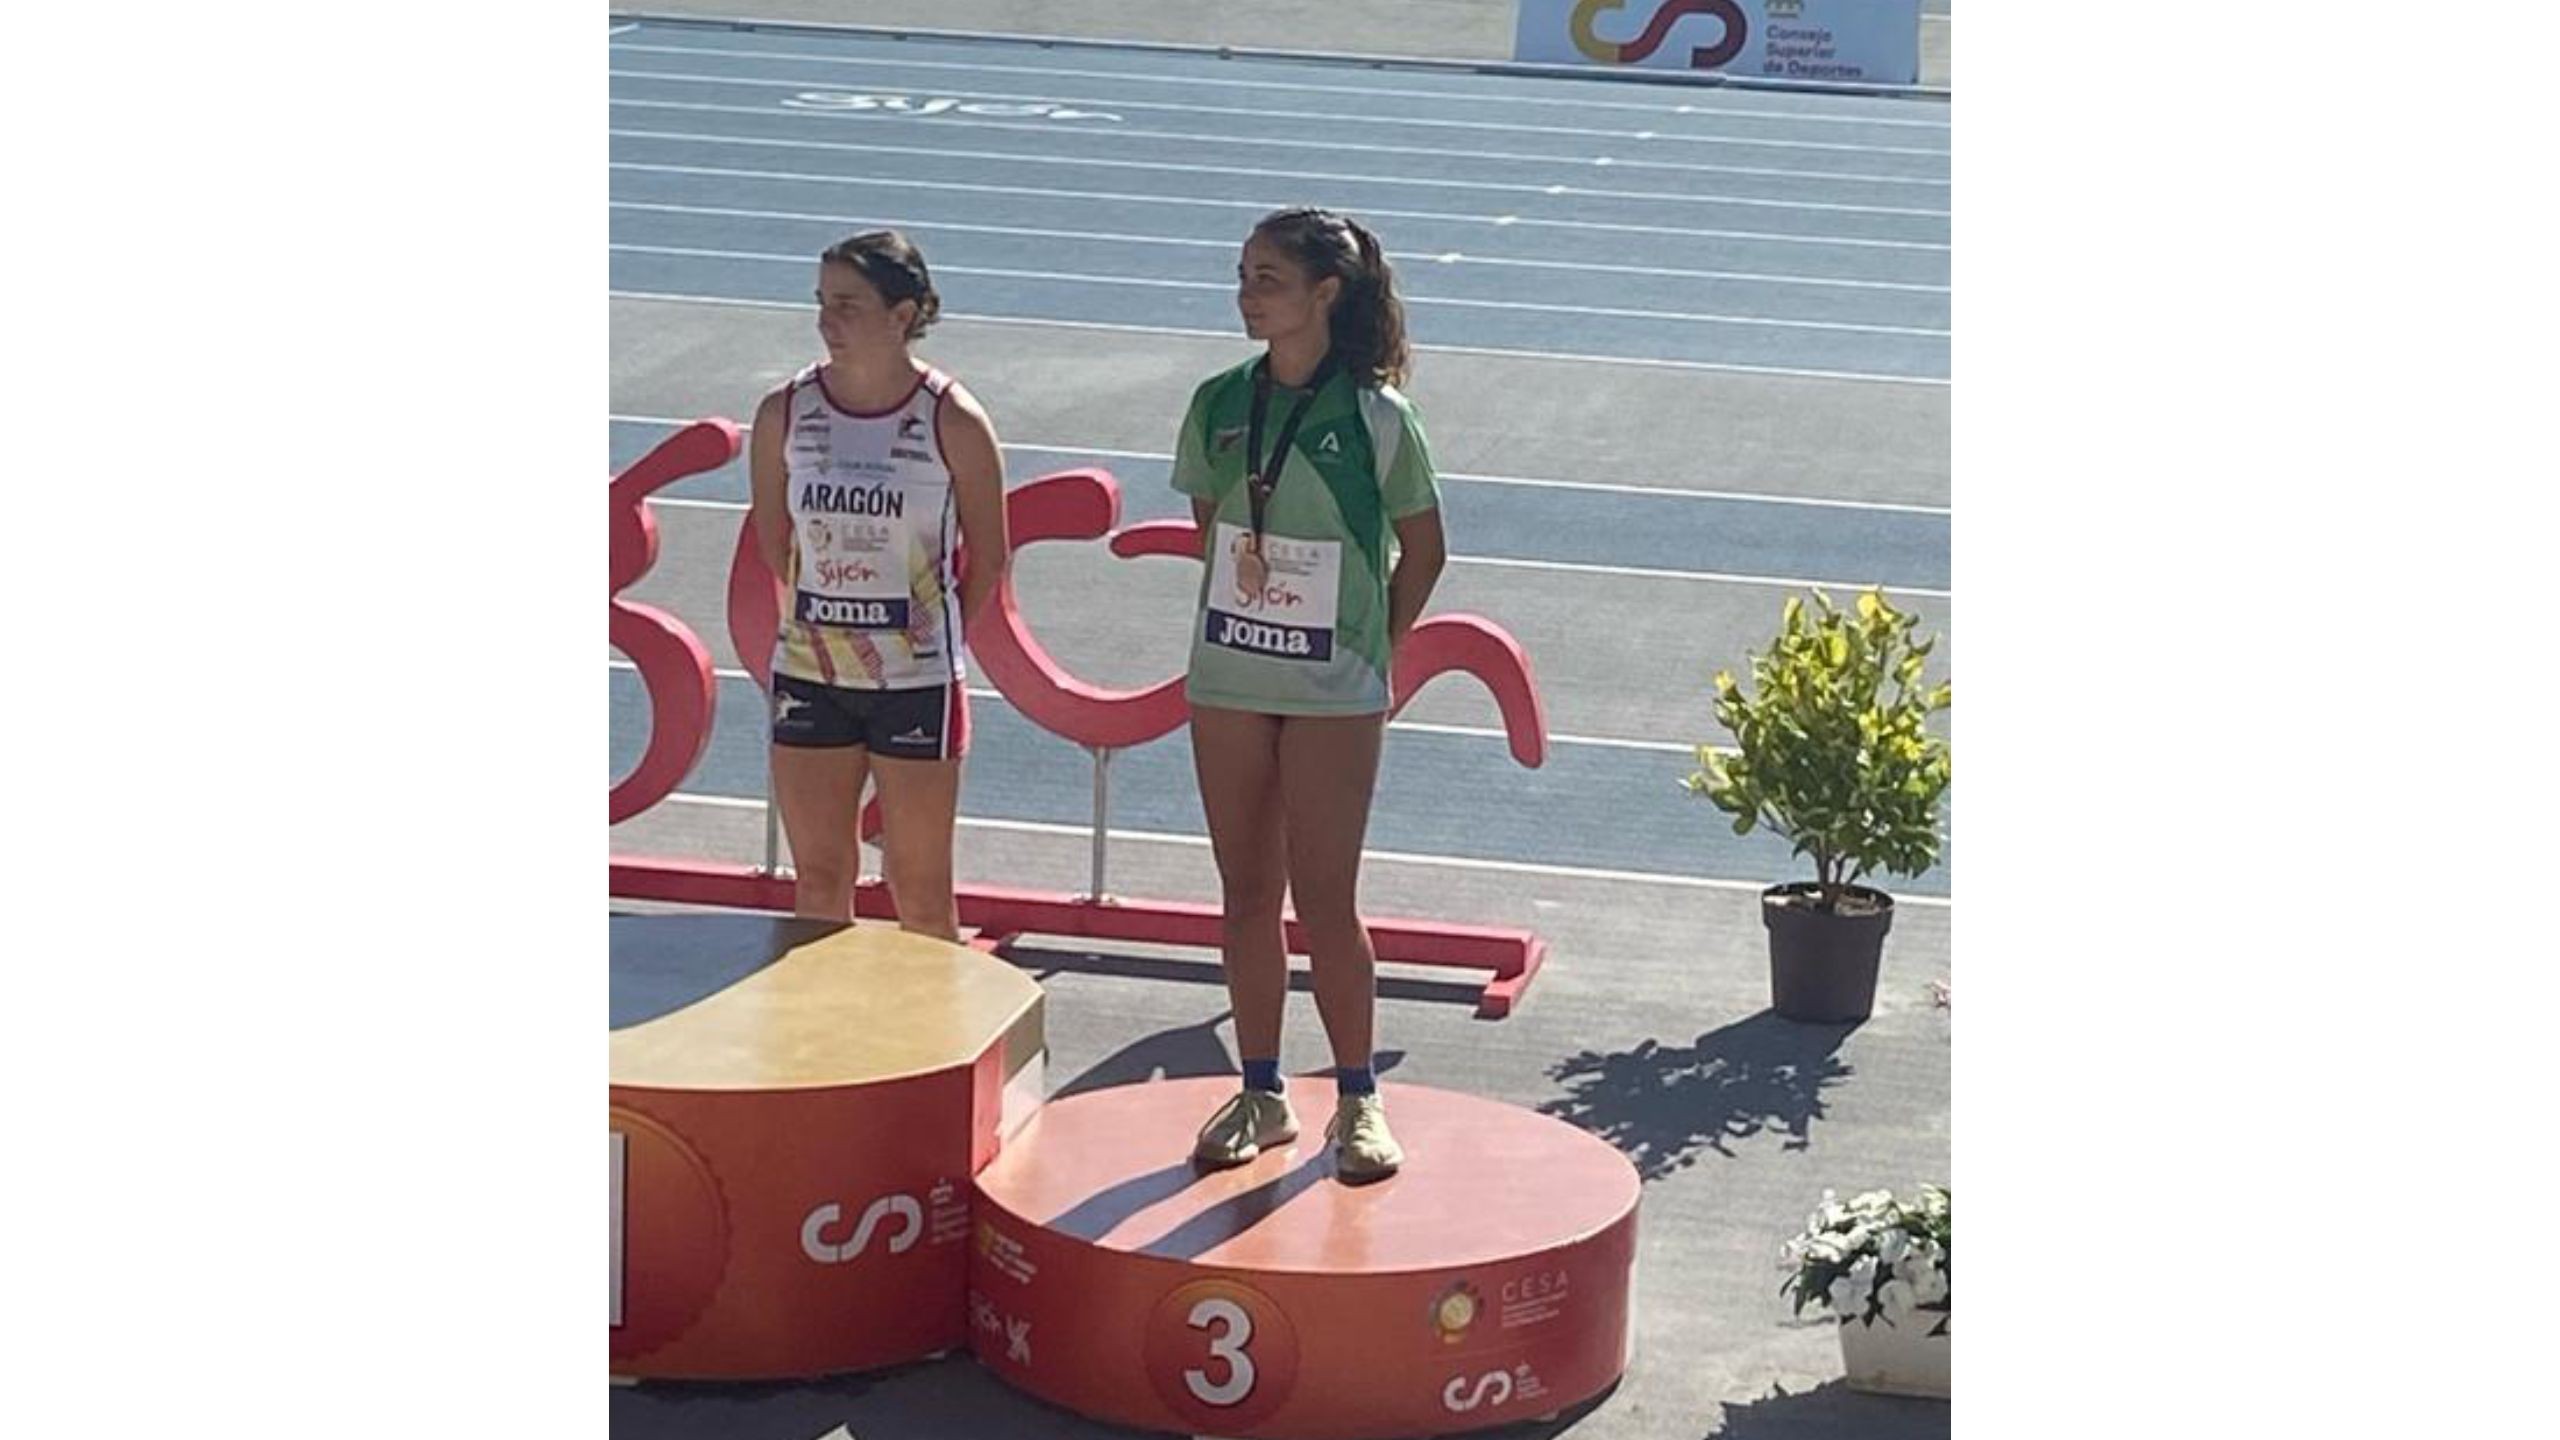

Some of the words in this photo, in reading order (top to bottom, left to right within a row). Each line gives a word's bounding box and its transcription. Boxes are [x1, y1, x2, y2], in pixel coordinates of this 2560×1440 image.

[801, 481, 904, 519] ARAGÓN
[1501, 1269, 1569, 1302] CESA
[1184, 1300, 1256, 1404] 3
